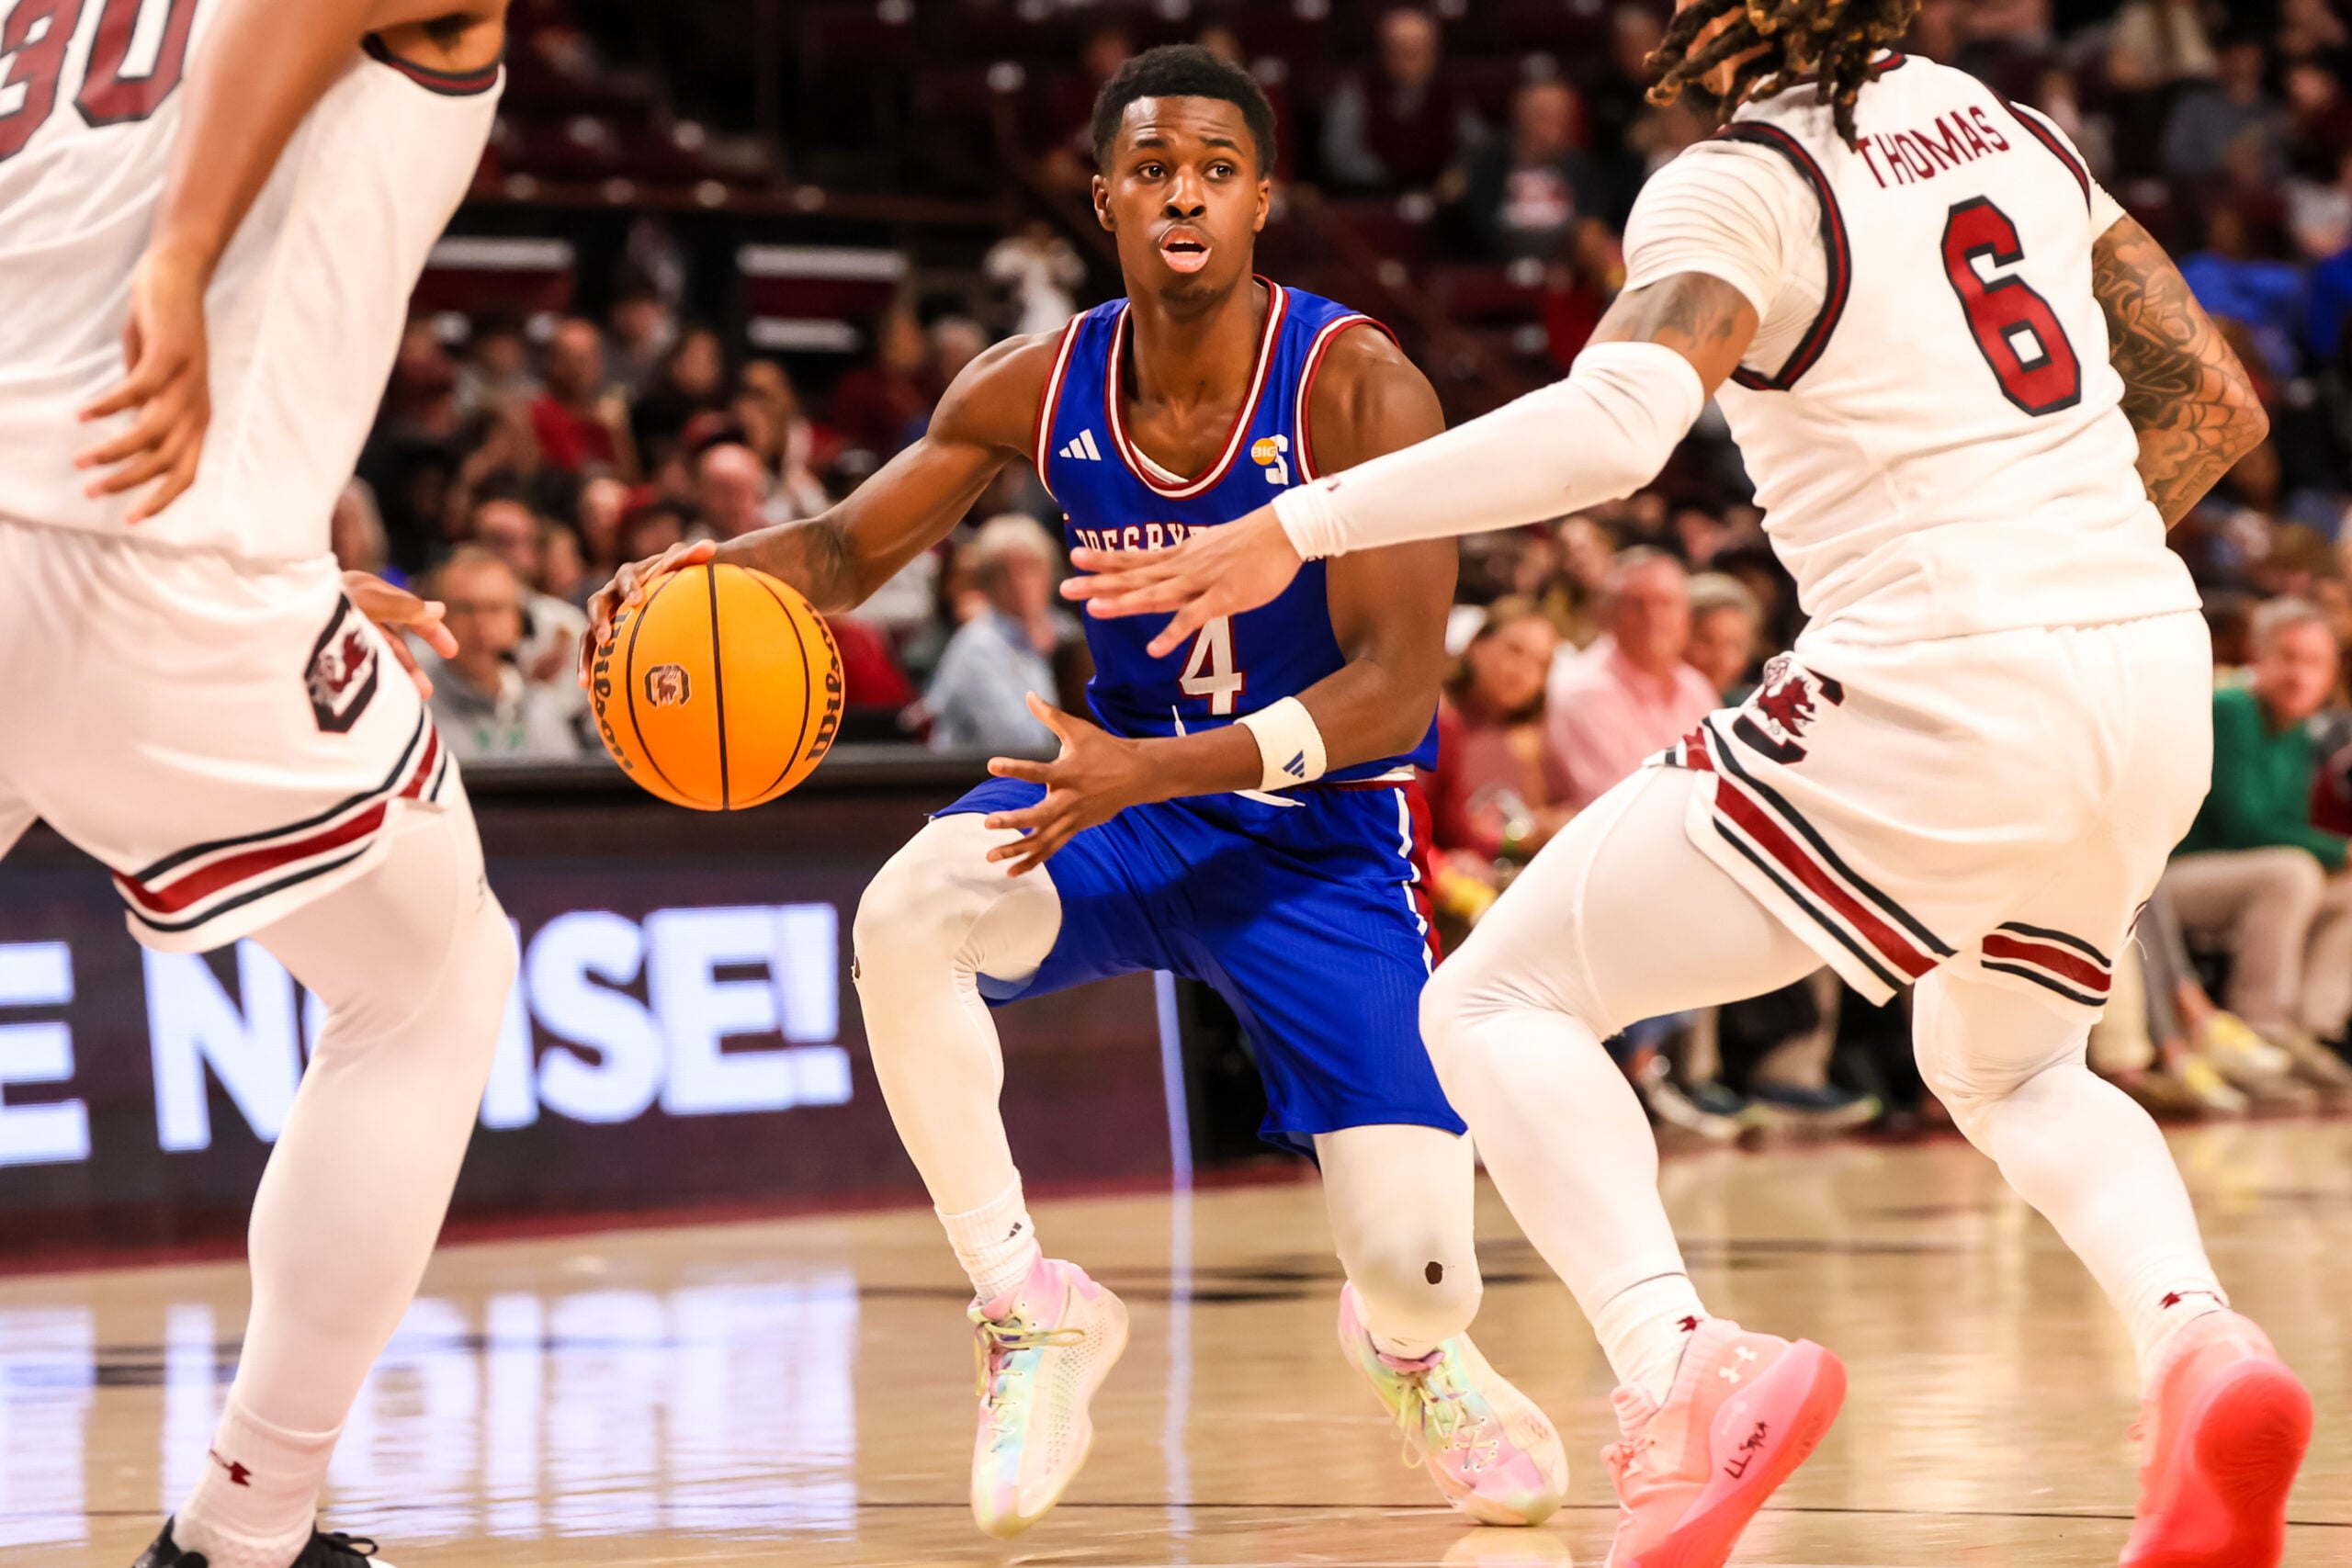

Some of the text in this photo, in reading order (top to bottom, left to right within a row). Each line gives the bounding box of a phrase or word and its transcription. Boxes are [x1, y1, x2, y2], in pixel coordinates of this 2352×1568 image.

[1856, 106, 2010, 189] THOMAS
[1940, 195, 2082, 417] 6
[1251, 446, 1278, 458] BIG
[1177, 615, 1247, 716] 4
[141, 902, 854, 1153] NSE!
